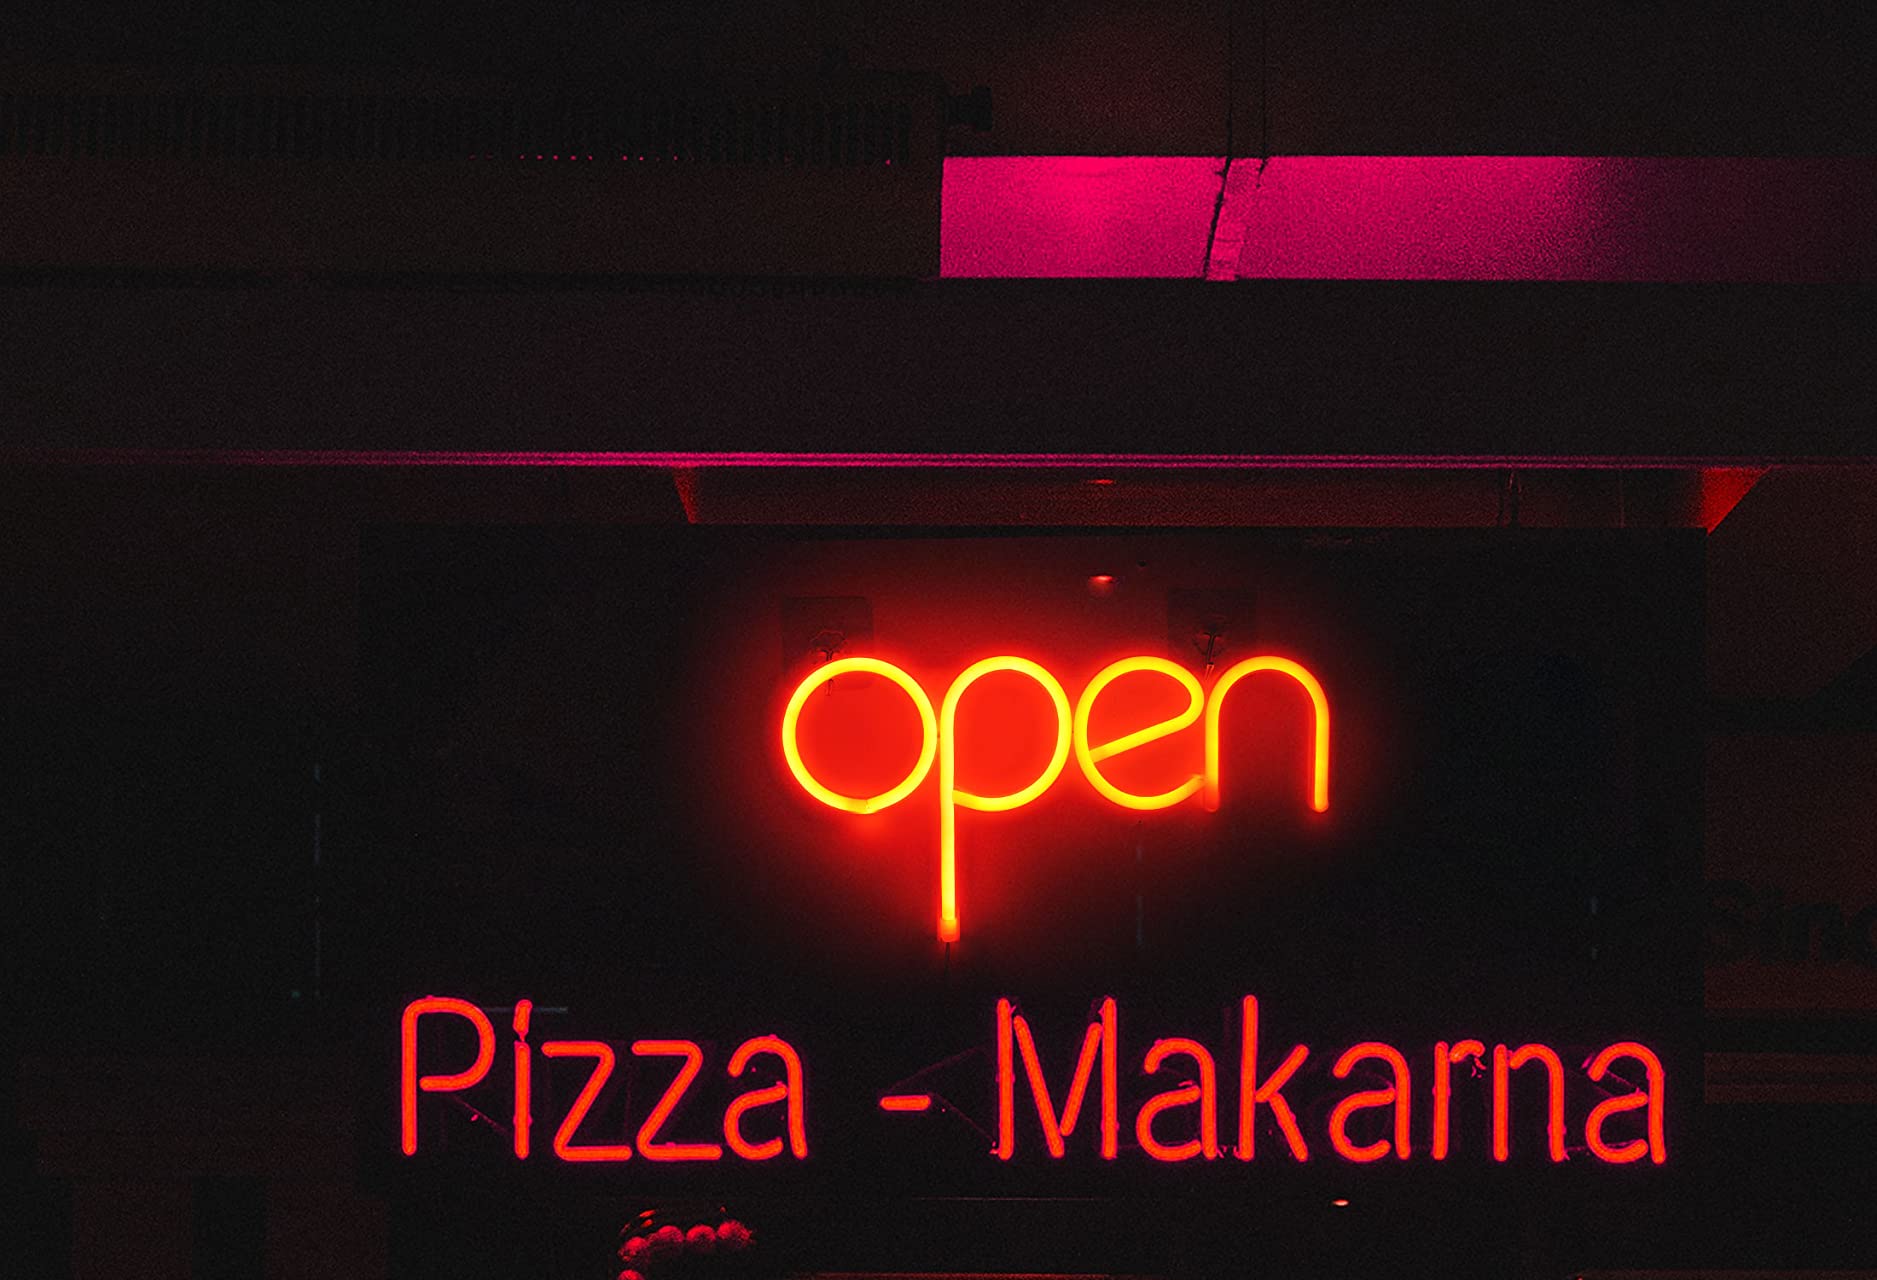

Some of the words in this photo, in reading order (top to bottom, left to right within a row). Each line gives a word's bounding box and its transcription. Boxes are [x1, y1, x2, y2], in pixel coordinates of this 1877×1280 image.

[780, 653, 1331, 942] open
[401, 996, 808, 1161] Pizza
[880, 1095, 931, 1111] -
[996, 995, 1667, 1164] Makarna
